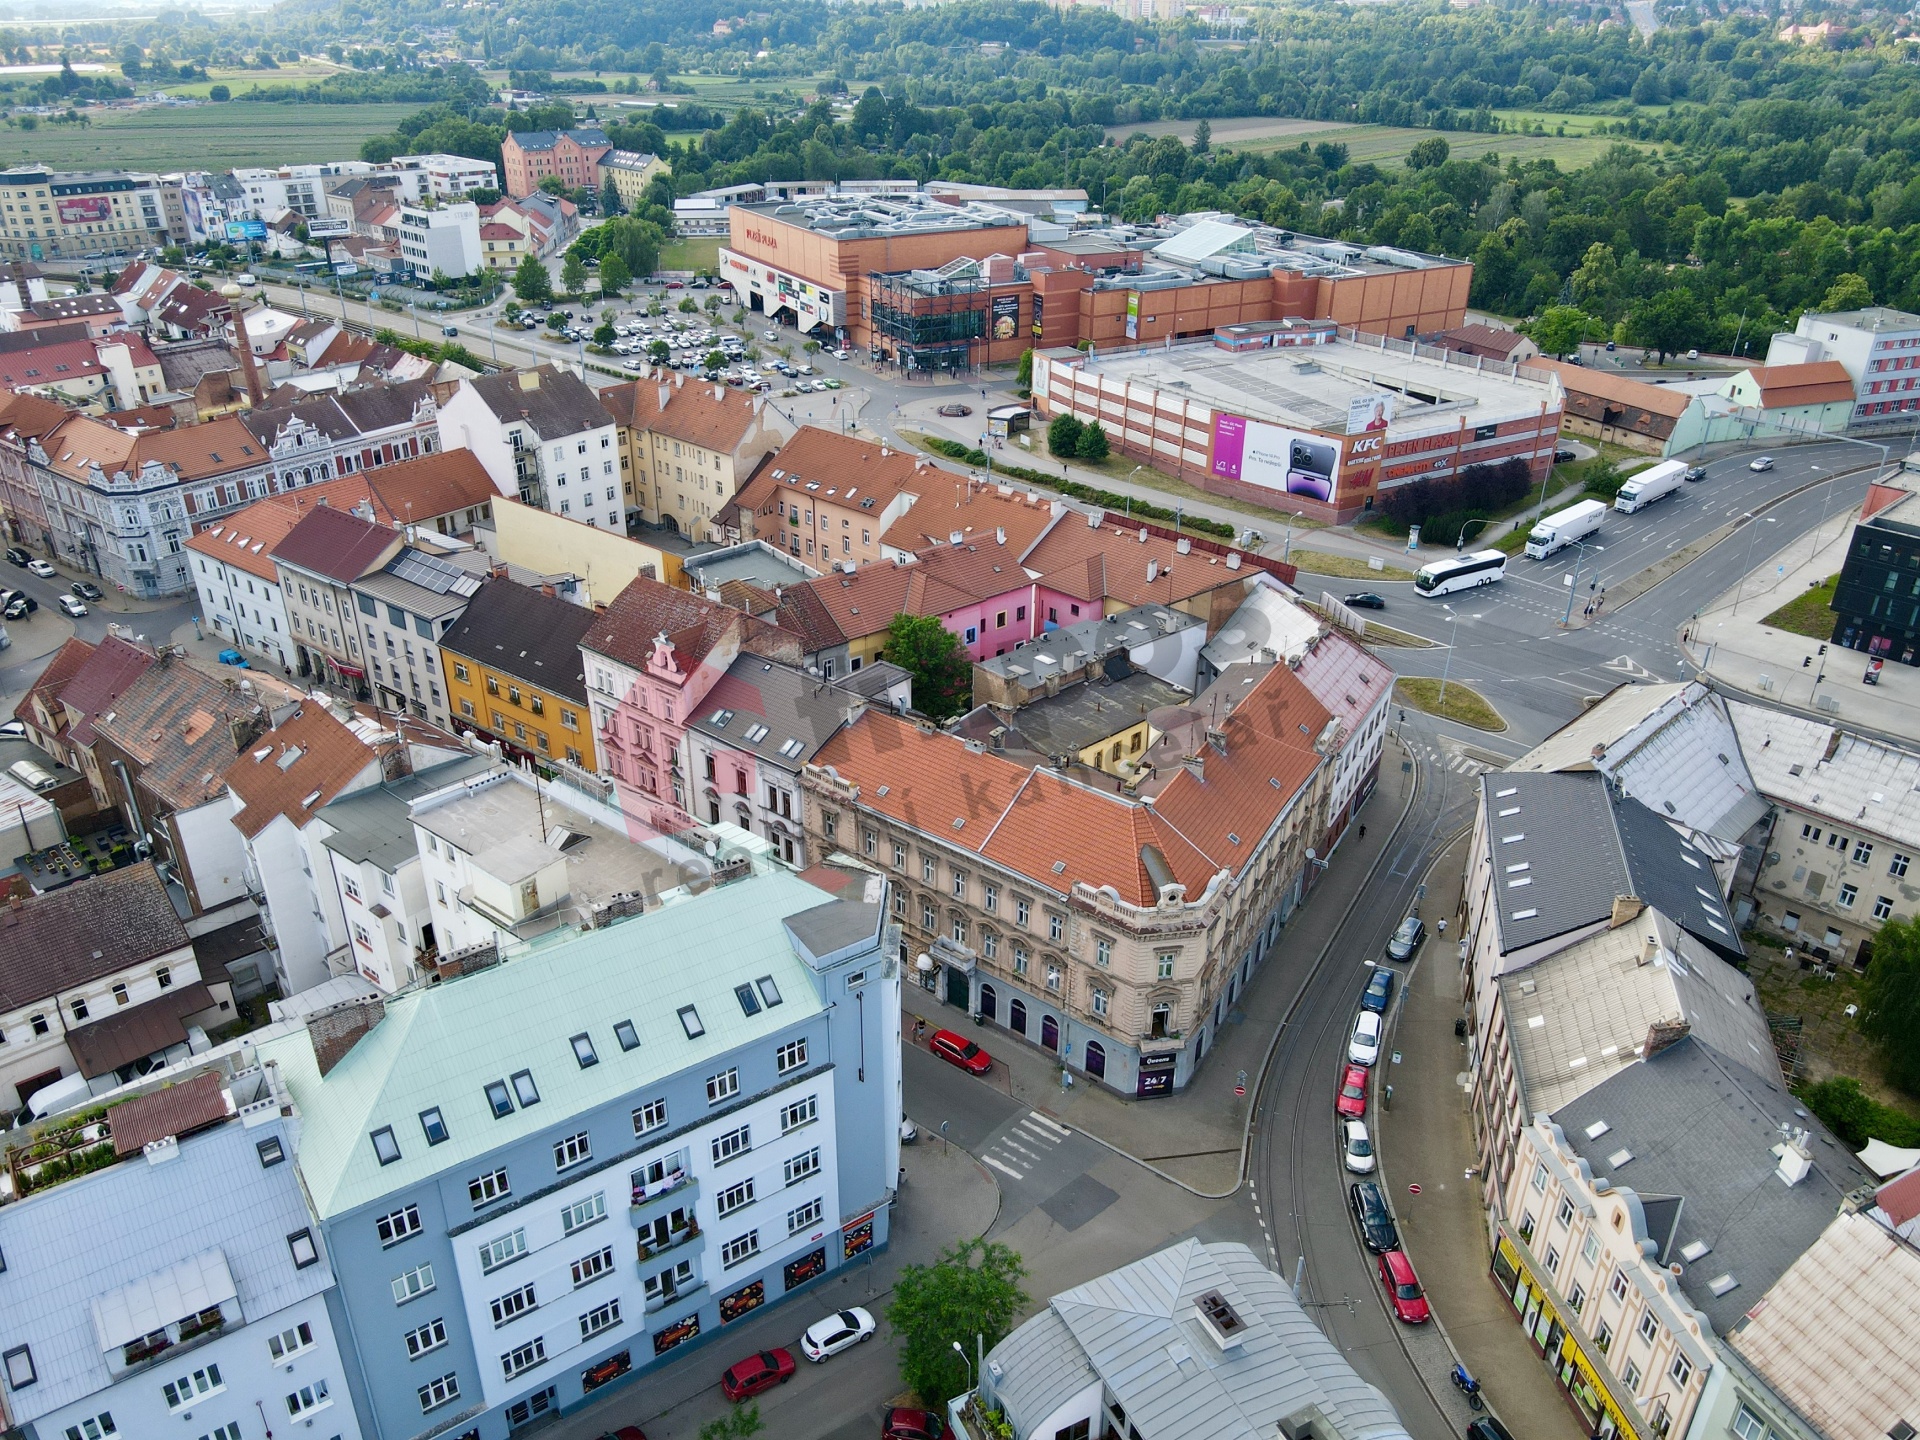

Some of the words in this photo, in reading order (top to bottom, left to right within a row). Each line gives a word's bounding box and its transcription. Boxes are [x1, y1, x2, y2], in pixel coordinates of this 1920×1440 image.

[1350, 437, 1382, 454] KFC
[1387, 465, 1415, 478] CINEMA
[1415, 461, 1430, 472] CITY
[1146, 1057, 1170, 1065] Queens
[1144, 1075, 1167, 1085] 24/7
[1579, 1363, 1607, 1406] CHIKKITA
